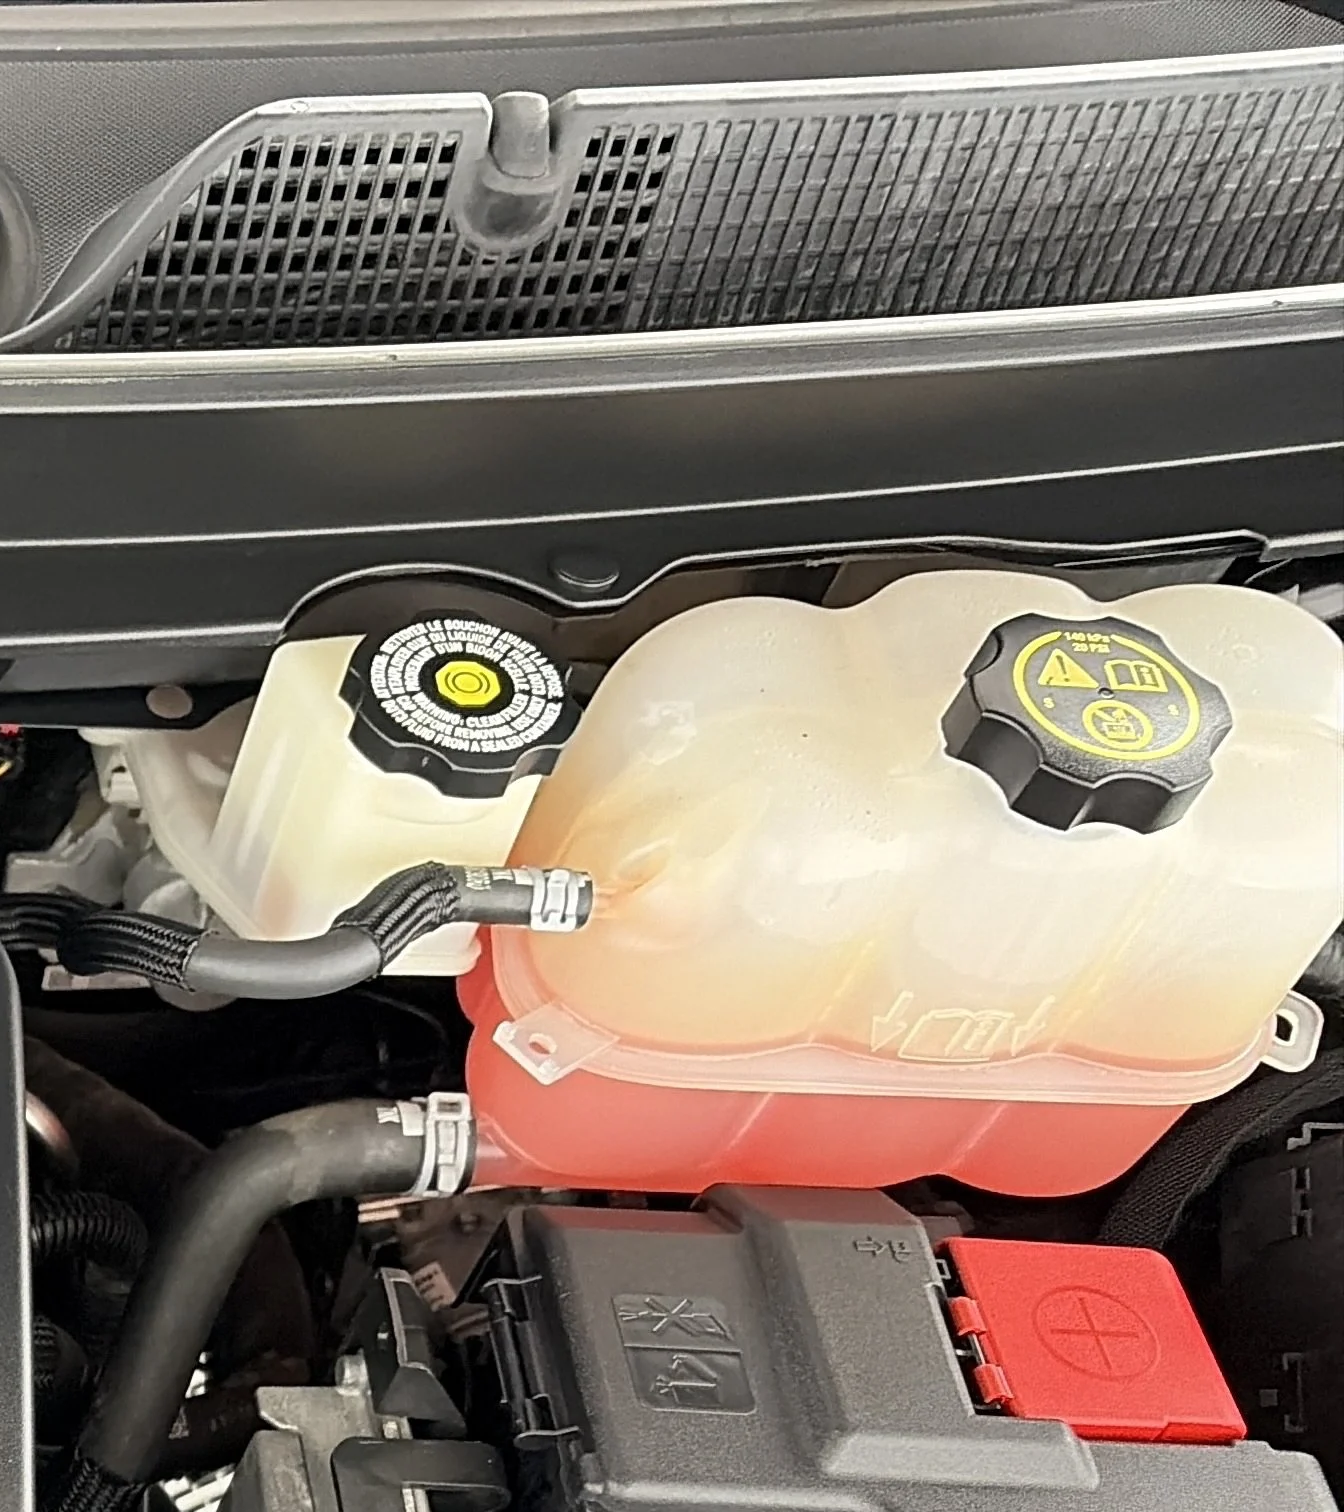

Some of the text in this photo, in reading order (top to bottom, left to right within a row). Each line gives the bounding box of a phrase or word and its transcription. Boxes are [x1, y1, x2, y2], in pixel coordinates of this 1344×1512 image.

[426, 619, 443, 632] LE
[444, 619, 502, 637] BOUCHON
[499, 631, 537, 655] AVANT
[531, 651, 548, 666] LA
[447, 631, 494, 646] LIQUIDE
[466, 644, 503, 662] BIDON
[395, 695, 417, 711] CAP
[410, 709, 454, 732] BEFORE
[466, 715, 505, 728] CLEAN
[401, 719, 433, 741] FLUID
[434, 736, 471, 751] FROM
[471, 741, 481, 752] A
[481, 736, 523, 752] SEALED
